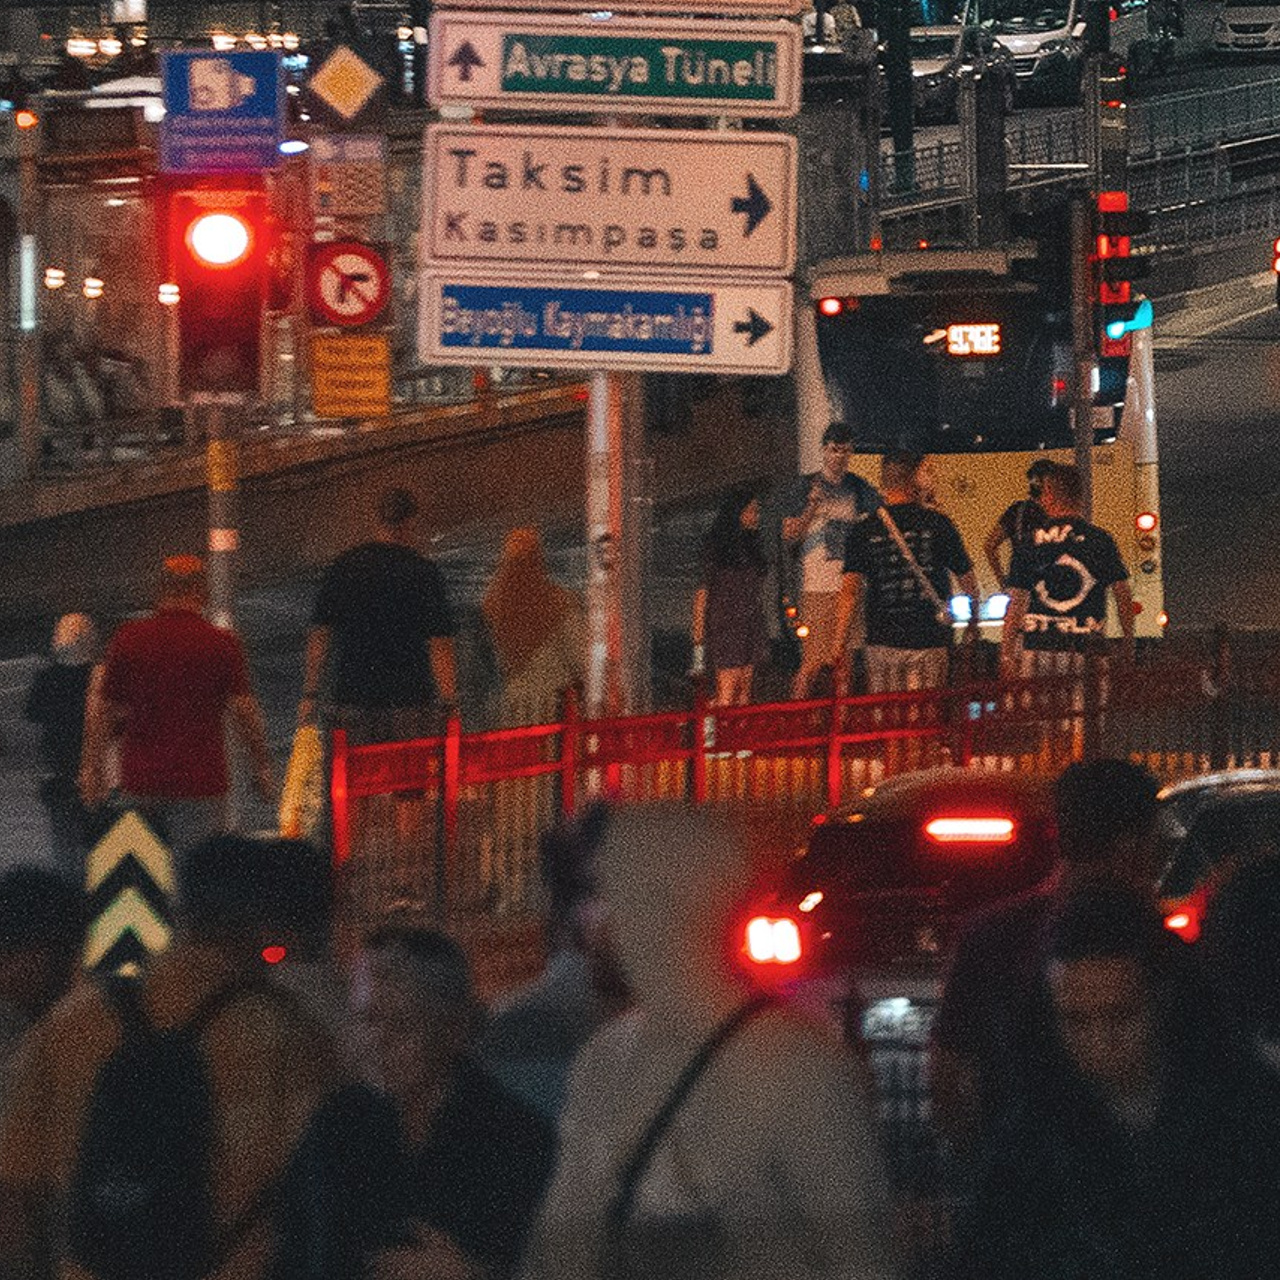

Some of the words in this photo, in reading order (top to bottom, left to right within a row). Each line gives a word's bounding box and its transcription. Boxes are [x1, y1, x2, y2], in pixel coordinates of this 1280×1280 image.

[504, 40, 649, 92] Avrasya
[660, 46, 777, 88] Tüneli
[449, 148, 673, 197] Taksim
